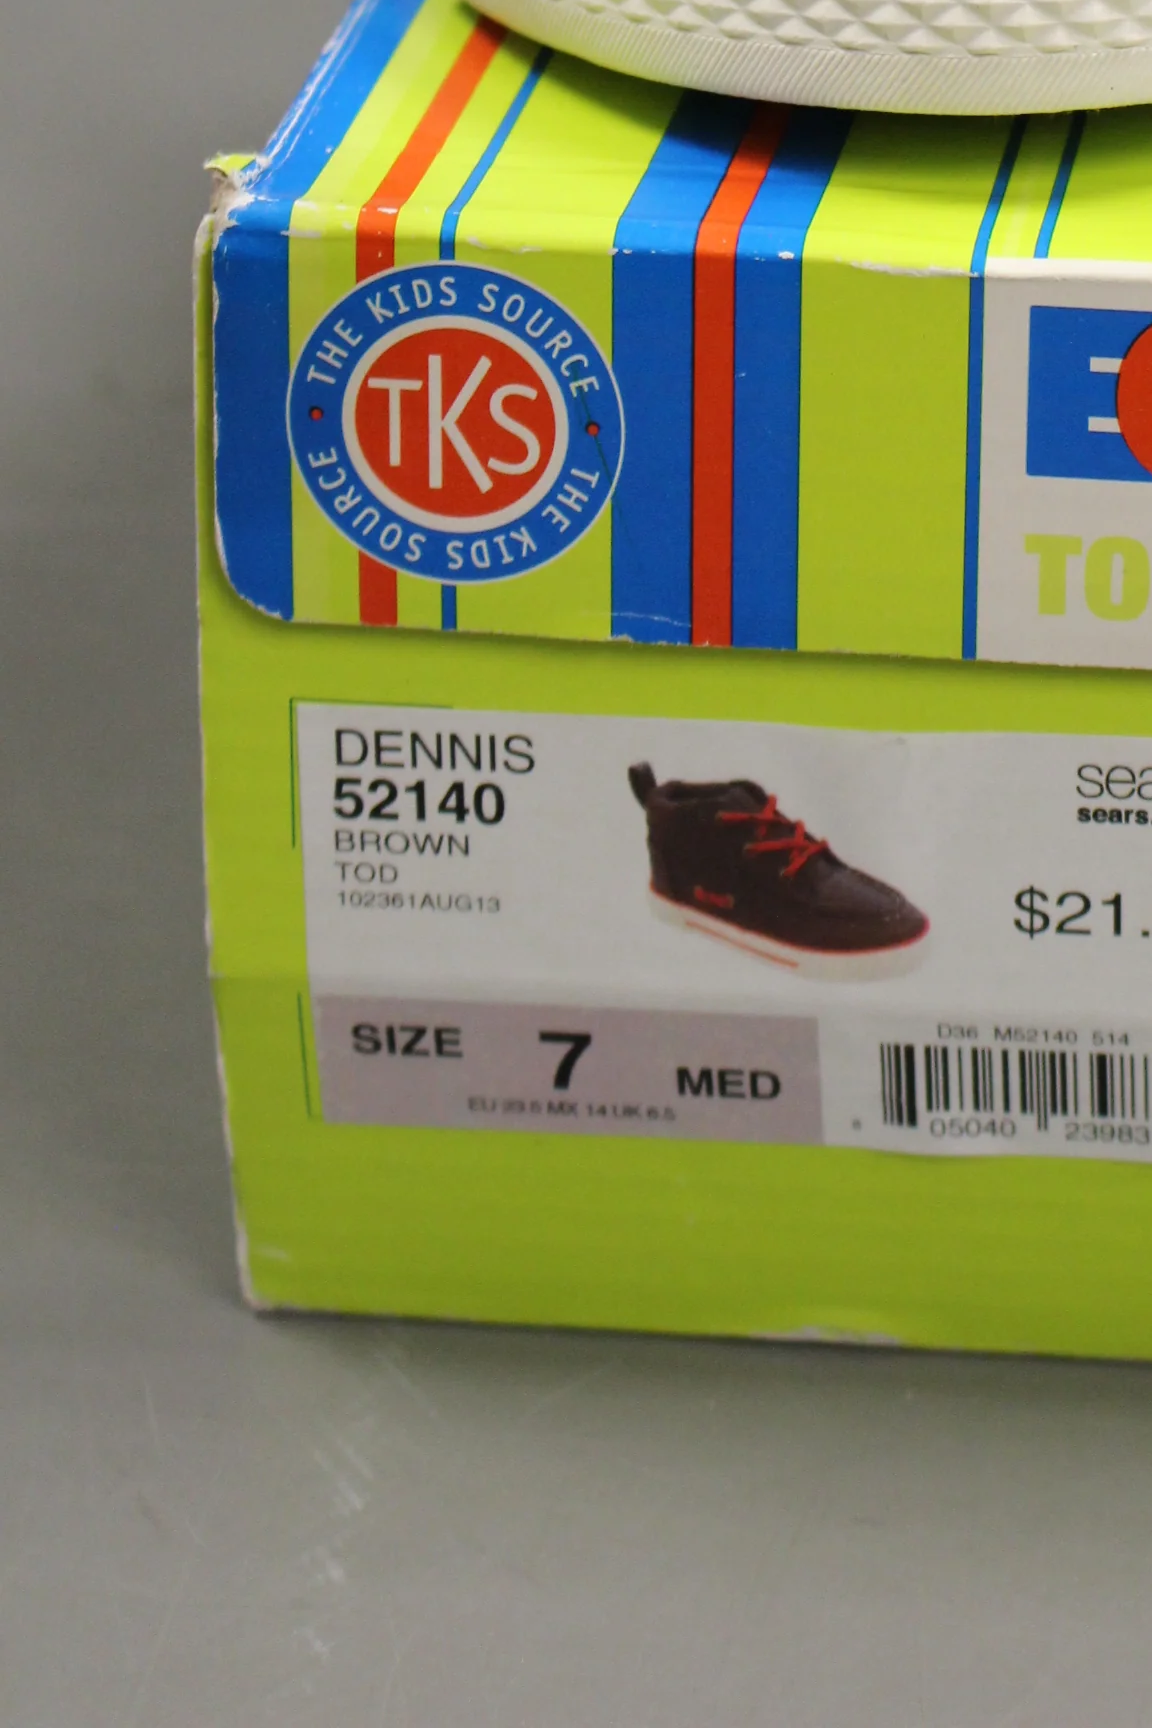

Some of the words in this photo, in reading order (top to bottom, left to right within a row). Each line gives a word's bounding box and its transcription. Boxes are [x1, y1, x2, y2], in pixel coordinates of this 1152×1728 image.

[307, 319, 363, 386] THE
[365, 276, 458, 324] KIDS
[477, 283, 600, 398] SOURCE
[367, 354, 541, 494] TKS
[308, 446, 427, 562] SOURCE
[541, 468, 600, 533] THE
[445, 526, 538, 570] KIDS
[334, 728, 537, 774] DENNIS
[333, 777, 506, 826] 52140
[334, 828, 471, 858] BROWN
[334, 860, 399, 885] TOD
[337, 890, 501, 914] 102361AUG13
[937, 1022, 979, 1041] D36
[993, 1025, 1078, 1046] M52140
[1092, 1029, 1131, 1047] 514
[351, 1023, 463, 1059] SIZE
[537, 1032, 592, 1091] 7
[675, 1066, 782, 1101] MED
[928, 1117, 1017, 1140] 05040
[1064, 1121, 1152, 1146] 23983
